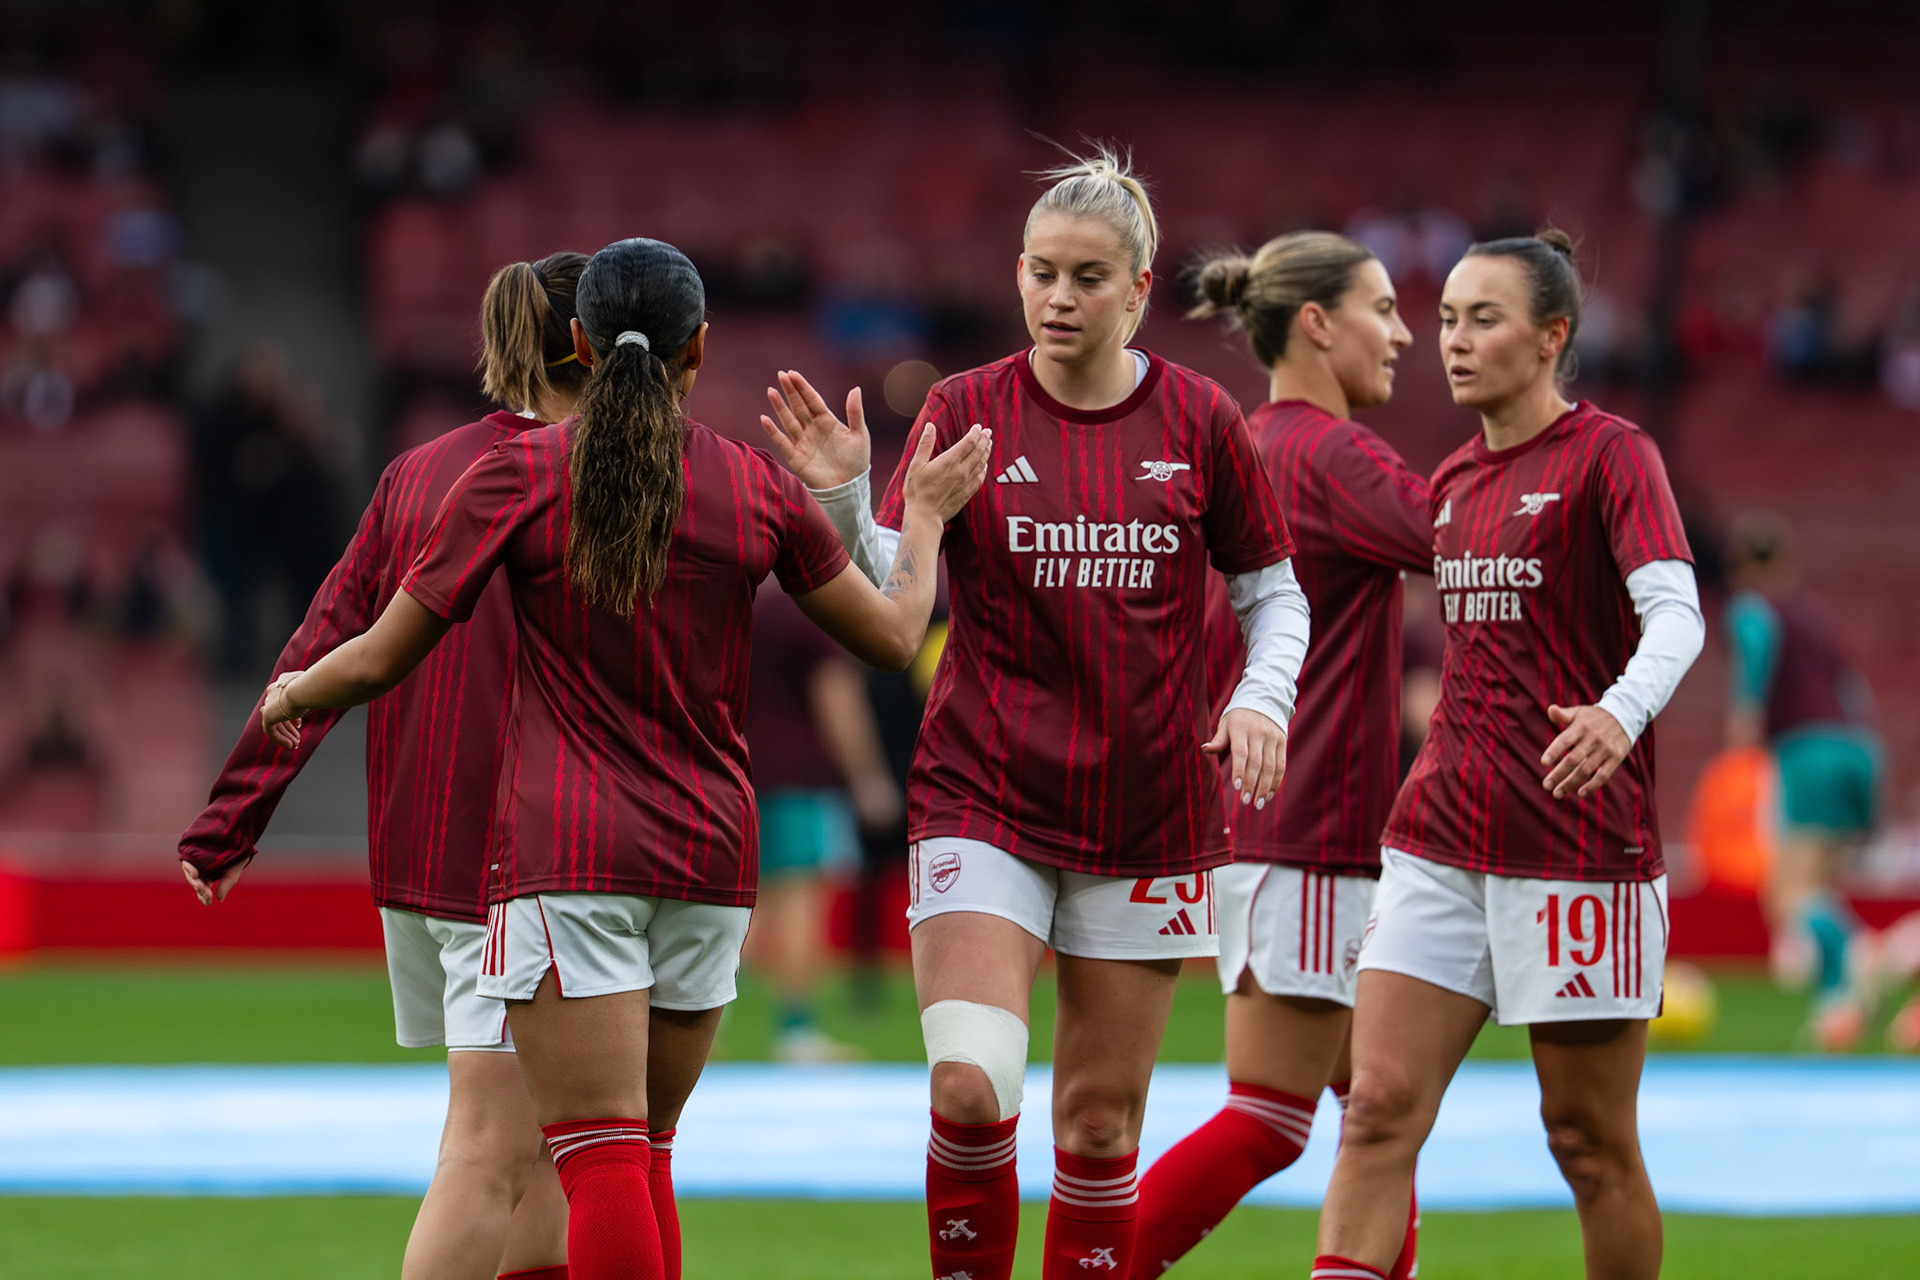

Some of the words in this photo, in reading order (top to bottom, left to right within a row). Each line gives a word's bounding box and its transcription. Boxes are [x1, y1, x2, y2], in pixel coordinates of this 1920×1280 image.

[1006, 514, 1180, 554] Emirates
[1033, 558, 1071, 588] FLY
[1076, 558, 1155, 589] BETTER
[1434, 550, 1543, 590] Emirates
[1464, 591, 1522, 622] BETTER
[932, 858, 955, 869] Arsenal
[1536, 893, 1607, 967] 19
